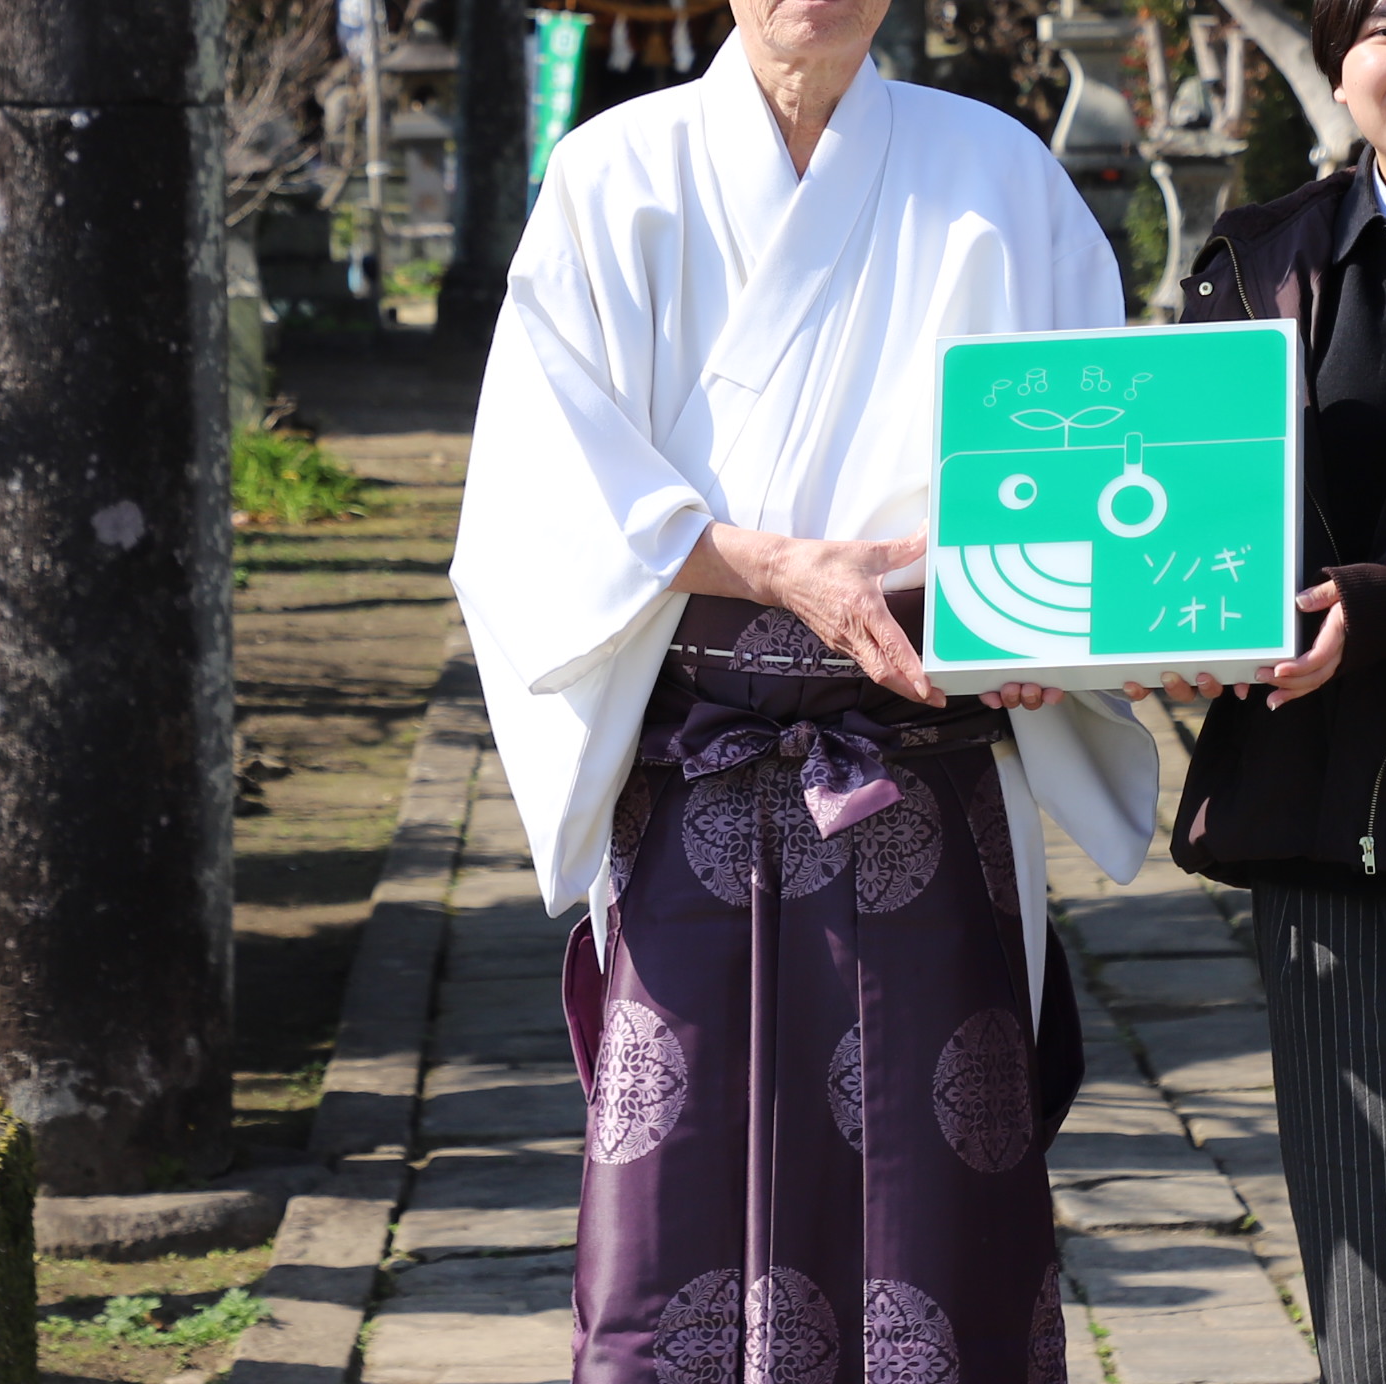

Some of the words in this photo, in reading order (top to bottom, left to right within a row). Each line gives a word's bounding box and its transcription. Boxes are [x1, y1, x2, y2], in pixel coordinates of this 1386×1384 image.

[1144, 545, 1252, 585] ソノギ
[1148, 596, 1243, 634] ノオト
